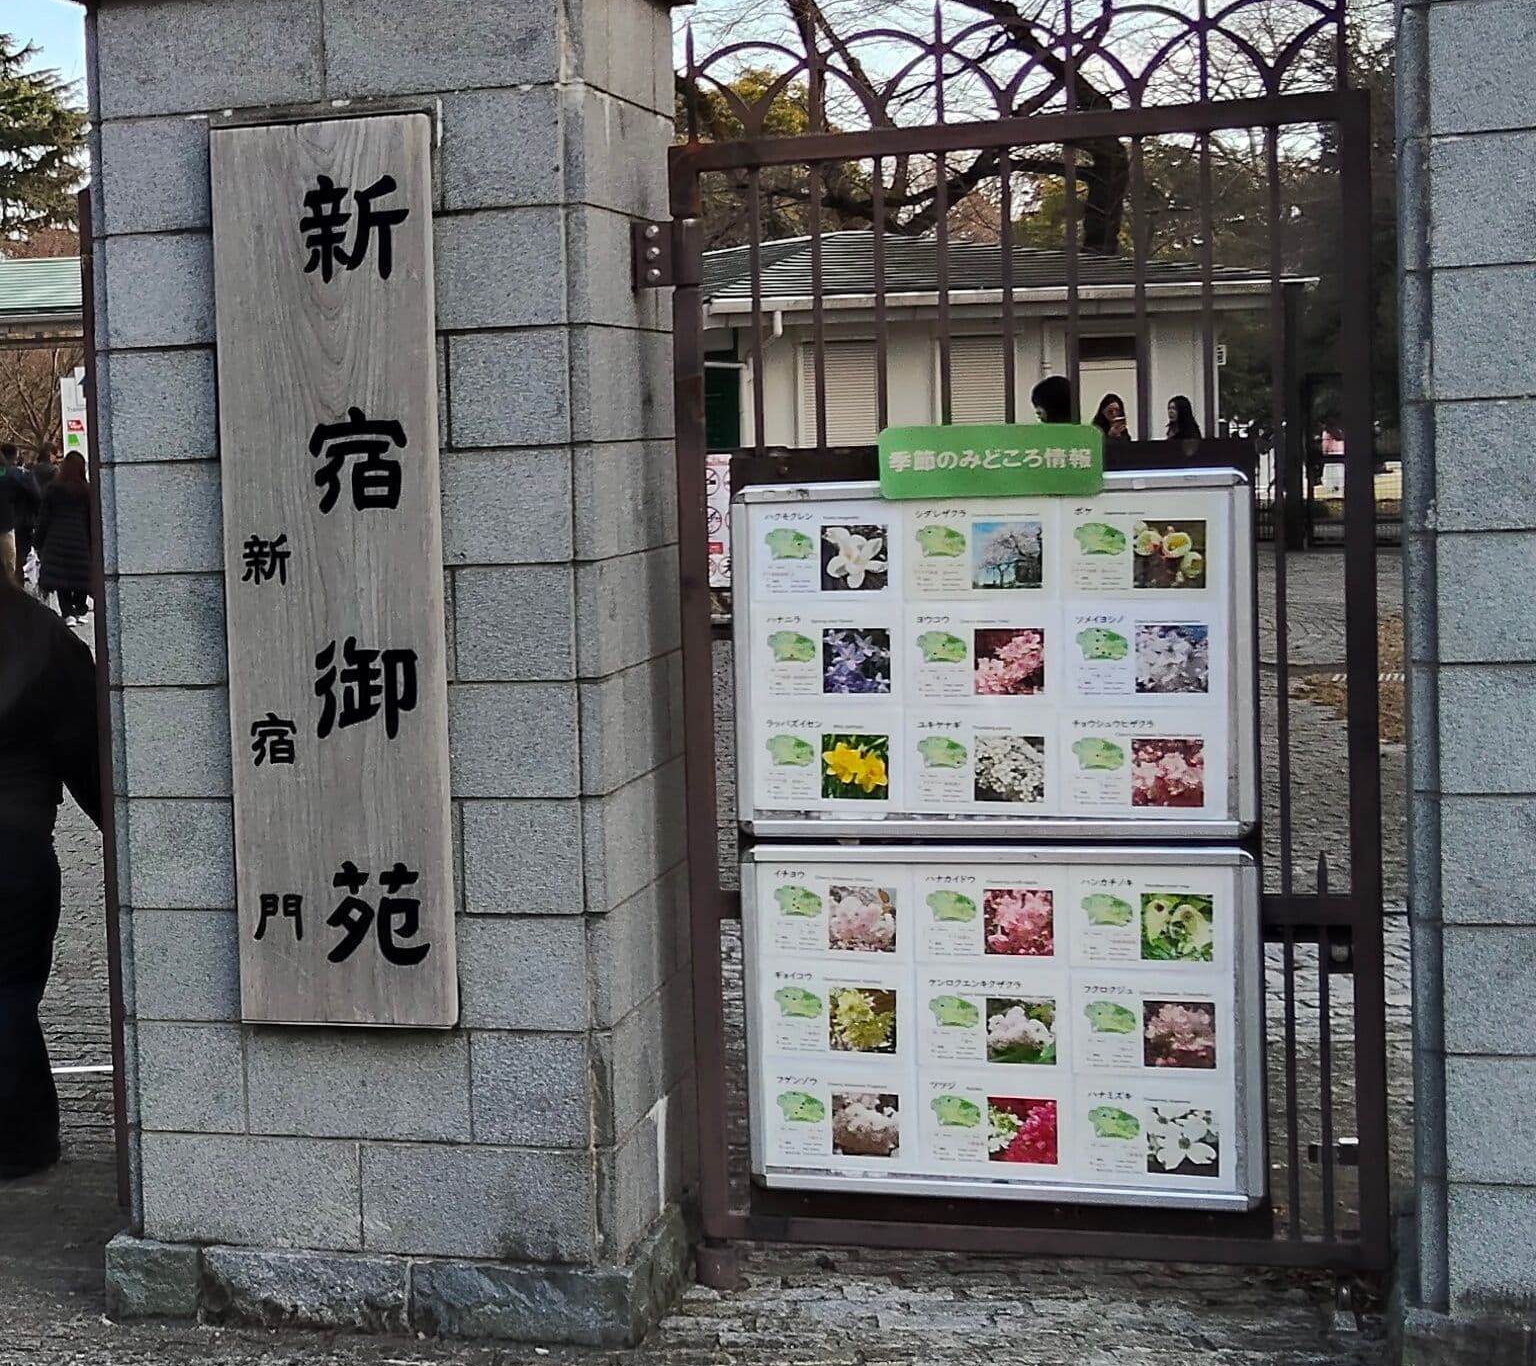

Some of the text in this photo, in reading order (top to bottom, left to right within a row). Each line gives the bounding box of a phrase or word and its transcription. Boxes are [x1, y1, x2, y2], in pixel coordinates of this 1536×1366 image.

[299, 173, 432, 967] 新宿御苑
[889, 448, 1092, 472] 季節のみどころ情報
[241, 532, 305, 944] 新宿門
